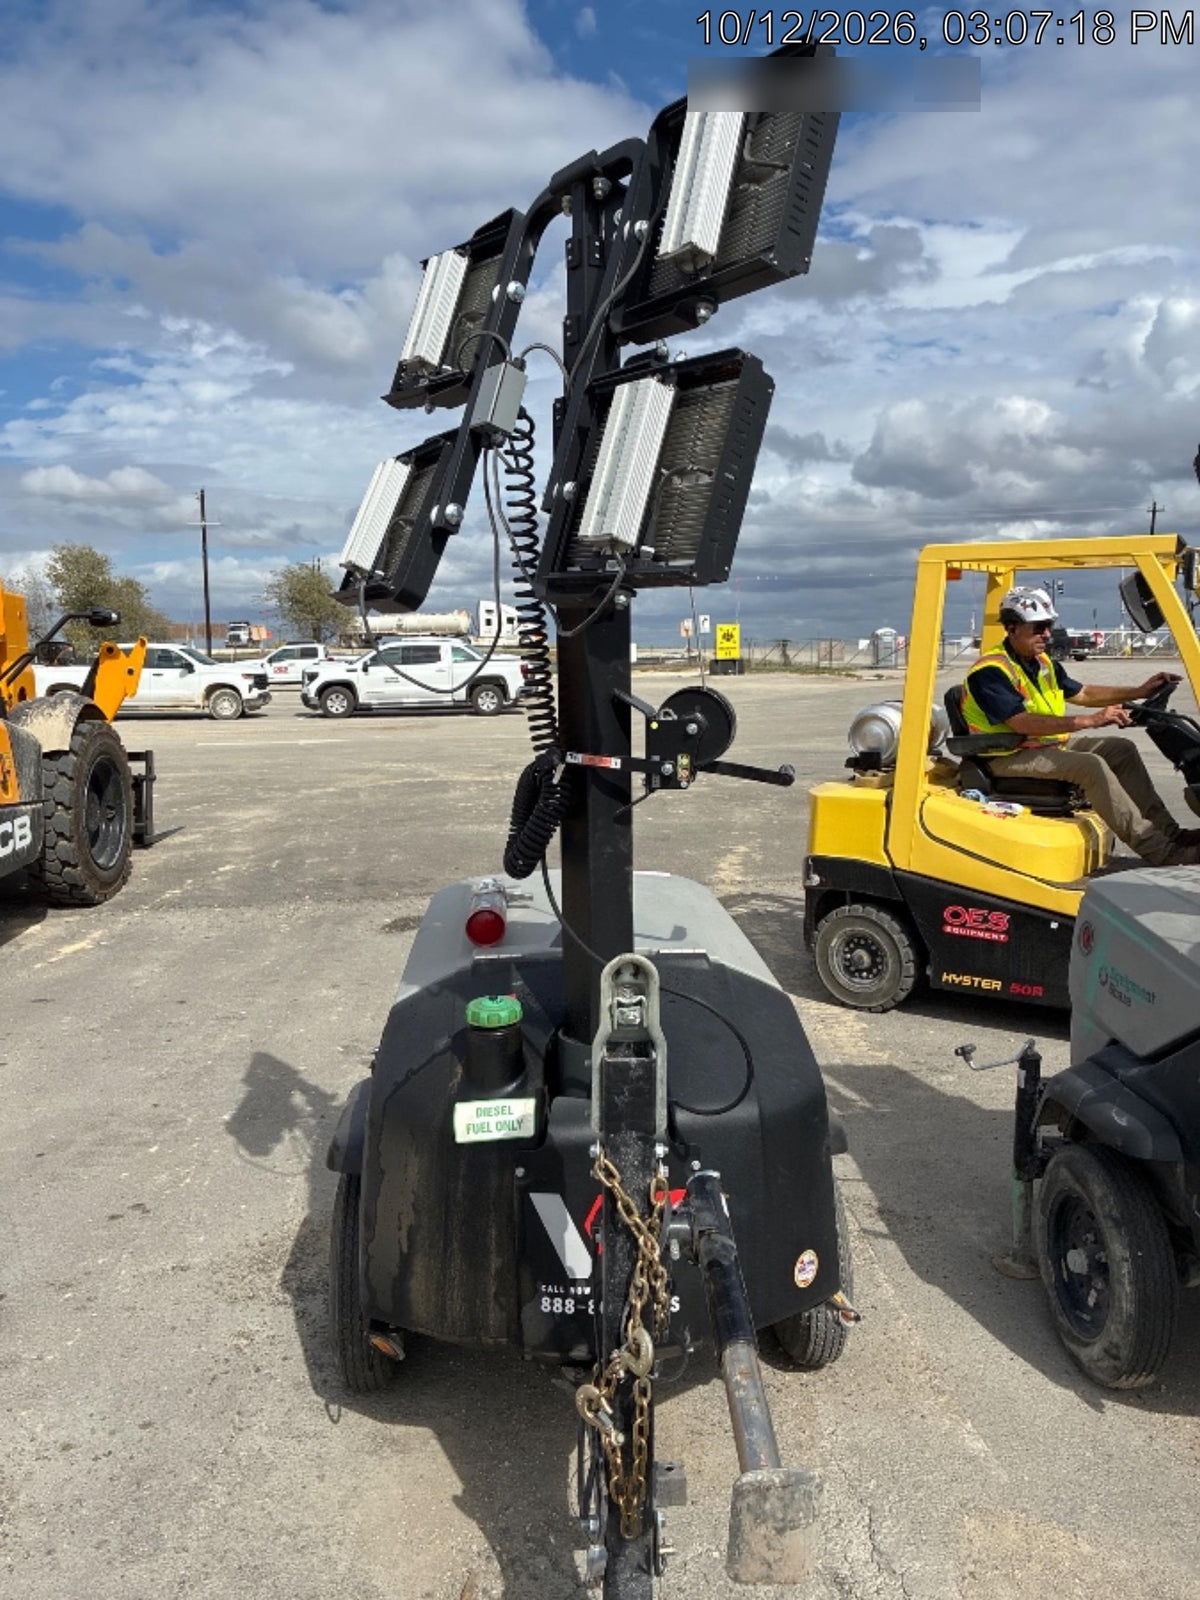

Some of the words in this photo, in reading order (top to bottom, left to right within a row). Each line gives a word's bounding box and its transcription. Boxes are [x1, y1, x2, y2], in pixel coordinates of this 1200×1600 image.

[944, 905, 1010, 932] OES
[944, 926, 1006, 941] EQUIPMENT
[942, 972, 1002, 991] HYSTER
[476, 1105, 515, 1118] DIESEL
[465, 1121, 493, 1135] FUEL
[495, 1118, 524, 1132] ONLY
